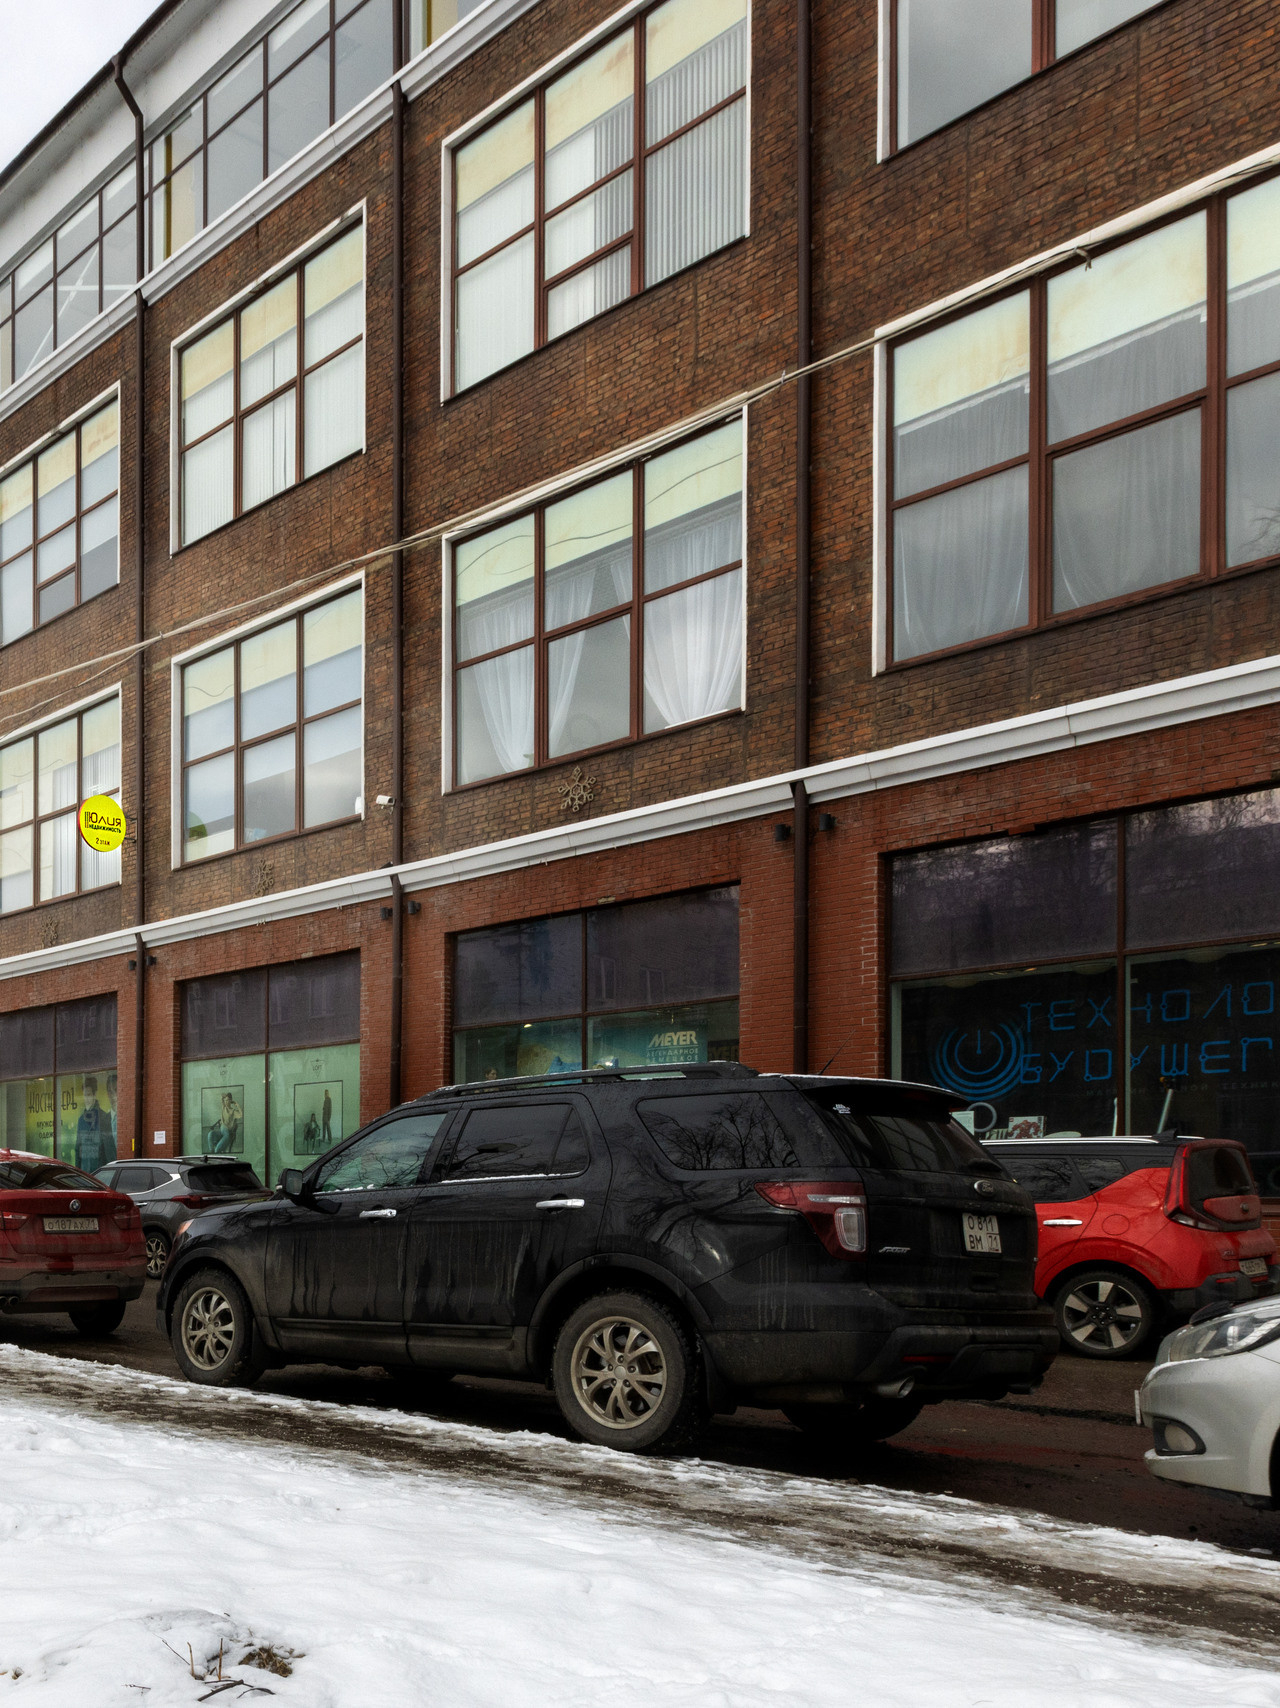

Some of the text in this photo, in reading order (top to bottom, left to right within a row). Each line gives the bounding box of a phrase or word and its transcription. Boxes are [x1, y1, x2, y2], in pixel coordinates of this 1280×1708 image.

[88, 823, 122, 834] НЕДВИЖИМОСТЬ
[95, 837, 99, 845] 2
[648, 1031, 698, 1047] MEYER
[646, 1048, 699, 1057] ЛЕГЕНДАРНОЕ
[28, 1087, 78, 1114] КОСТЮЕРЪ
